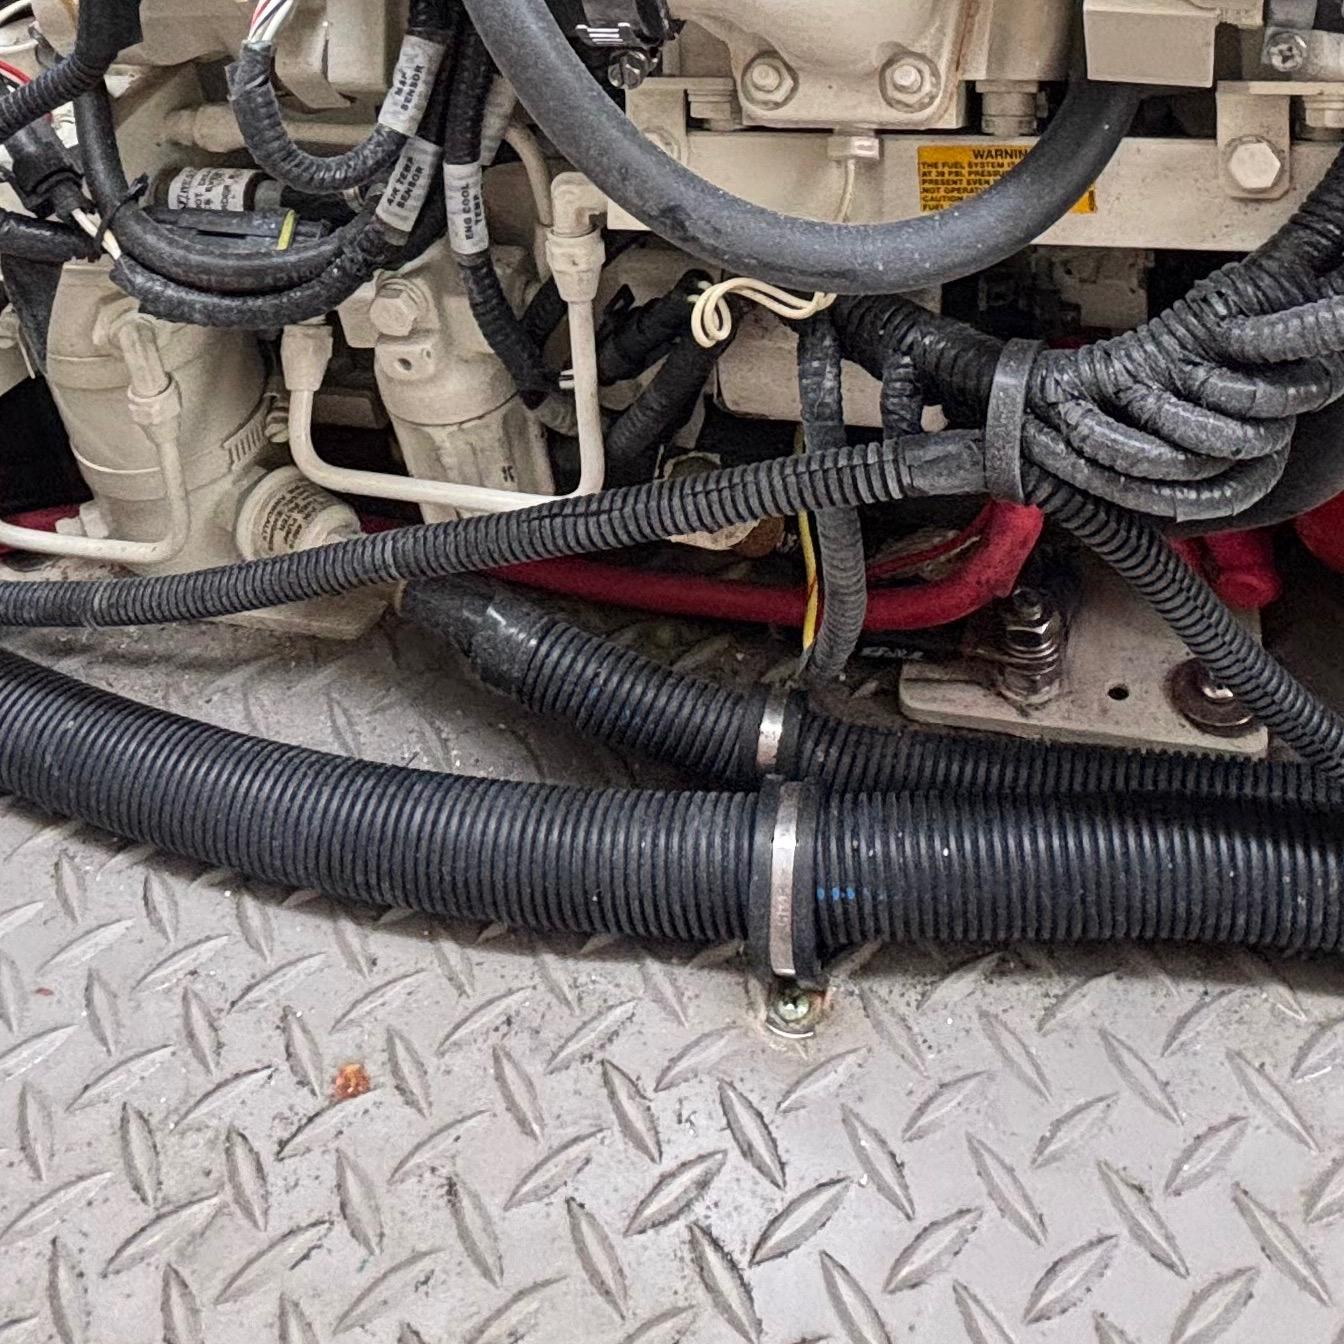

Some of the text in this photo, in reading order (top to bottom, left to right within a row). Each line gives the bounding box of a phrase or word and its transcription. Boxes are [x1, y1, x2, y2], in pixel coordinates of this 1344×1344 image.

[400, 64, 425, 112] SENSOR
[972, 148, 1029, 160] WARNIN
[396, 156, 415, 186] TEMP
[942, 162, 966, 170] FUEL
[967, 161, 1005, 169] SYSTEM
[396, 165, 425, 209] SENSOR
[921, 187, 942, 195] NOT
[922, 195, 965, 203] CAUTION
[460, 183, 474, 241] ENG COOL
